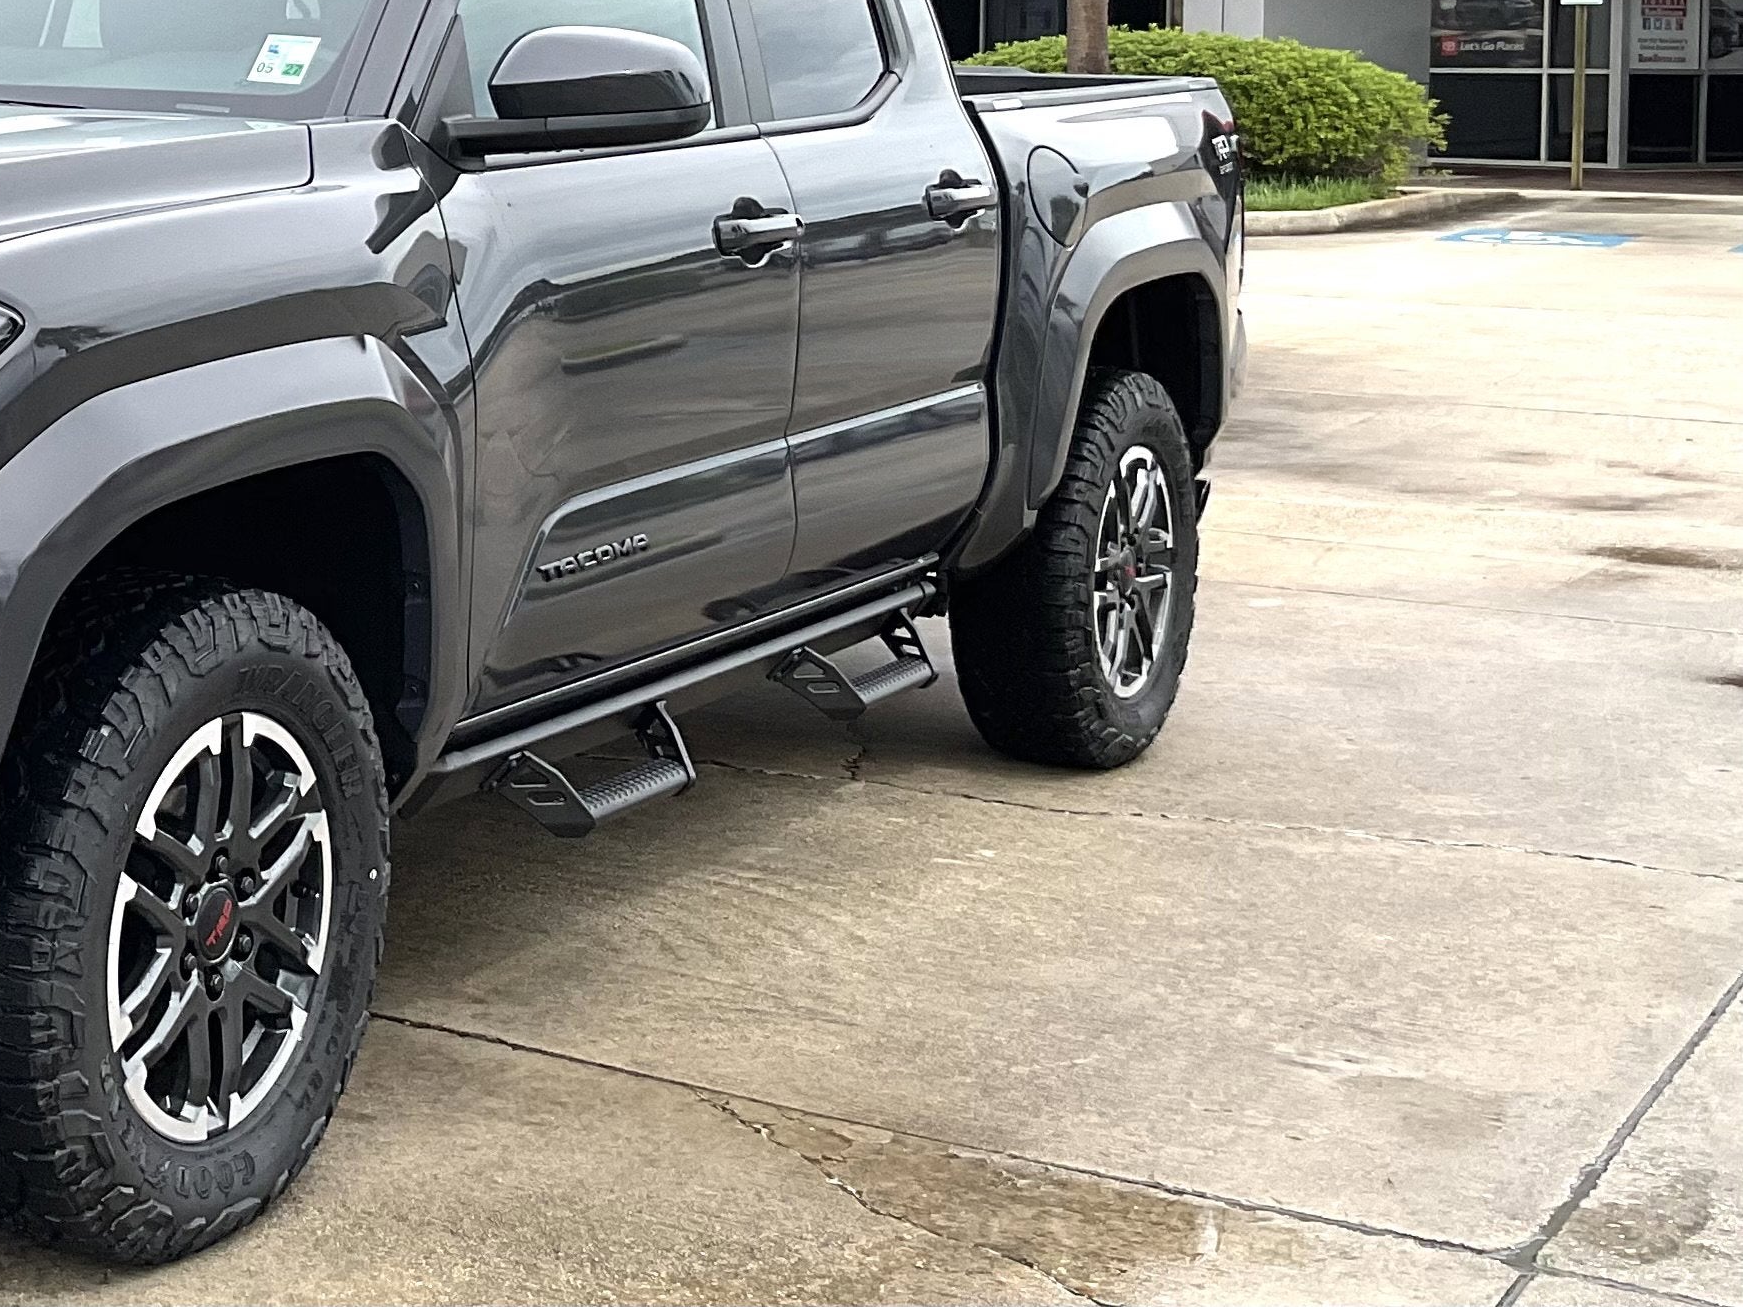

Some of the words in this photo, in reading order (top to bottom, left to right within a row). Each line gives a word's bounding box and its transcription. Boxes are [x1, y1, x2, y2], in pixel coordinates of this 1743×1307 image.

[256, 62, 274, 74] 05
[283, 63, 304, 76] 27
[536, 533, 649, 582] TACOMA
